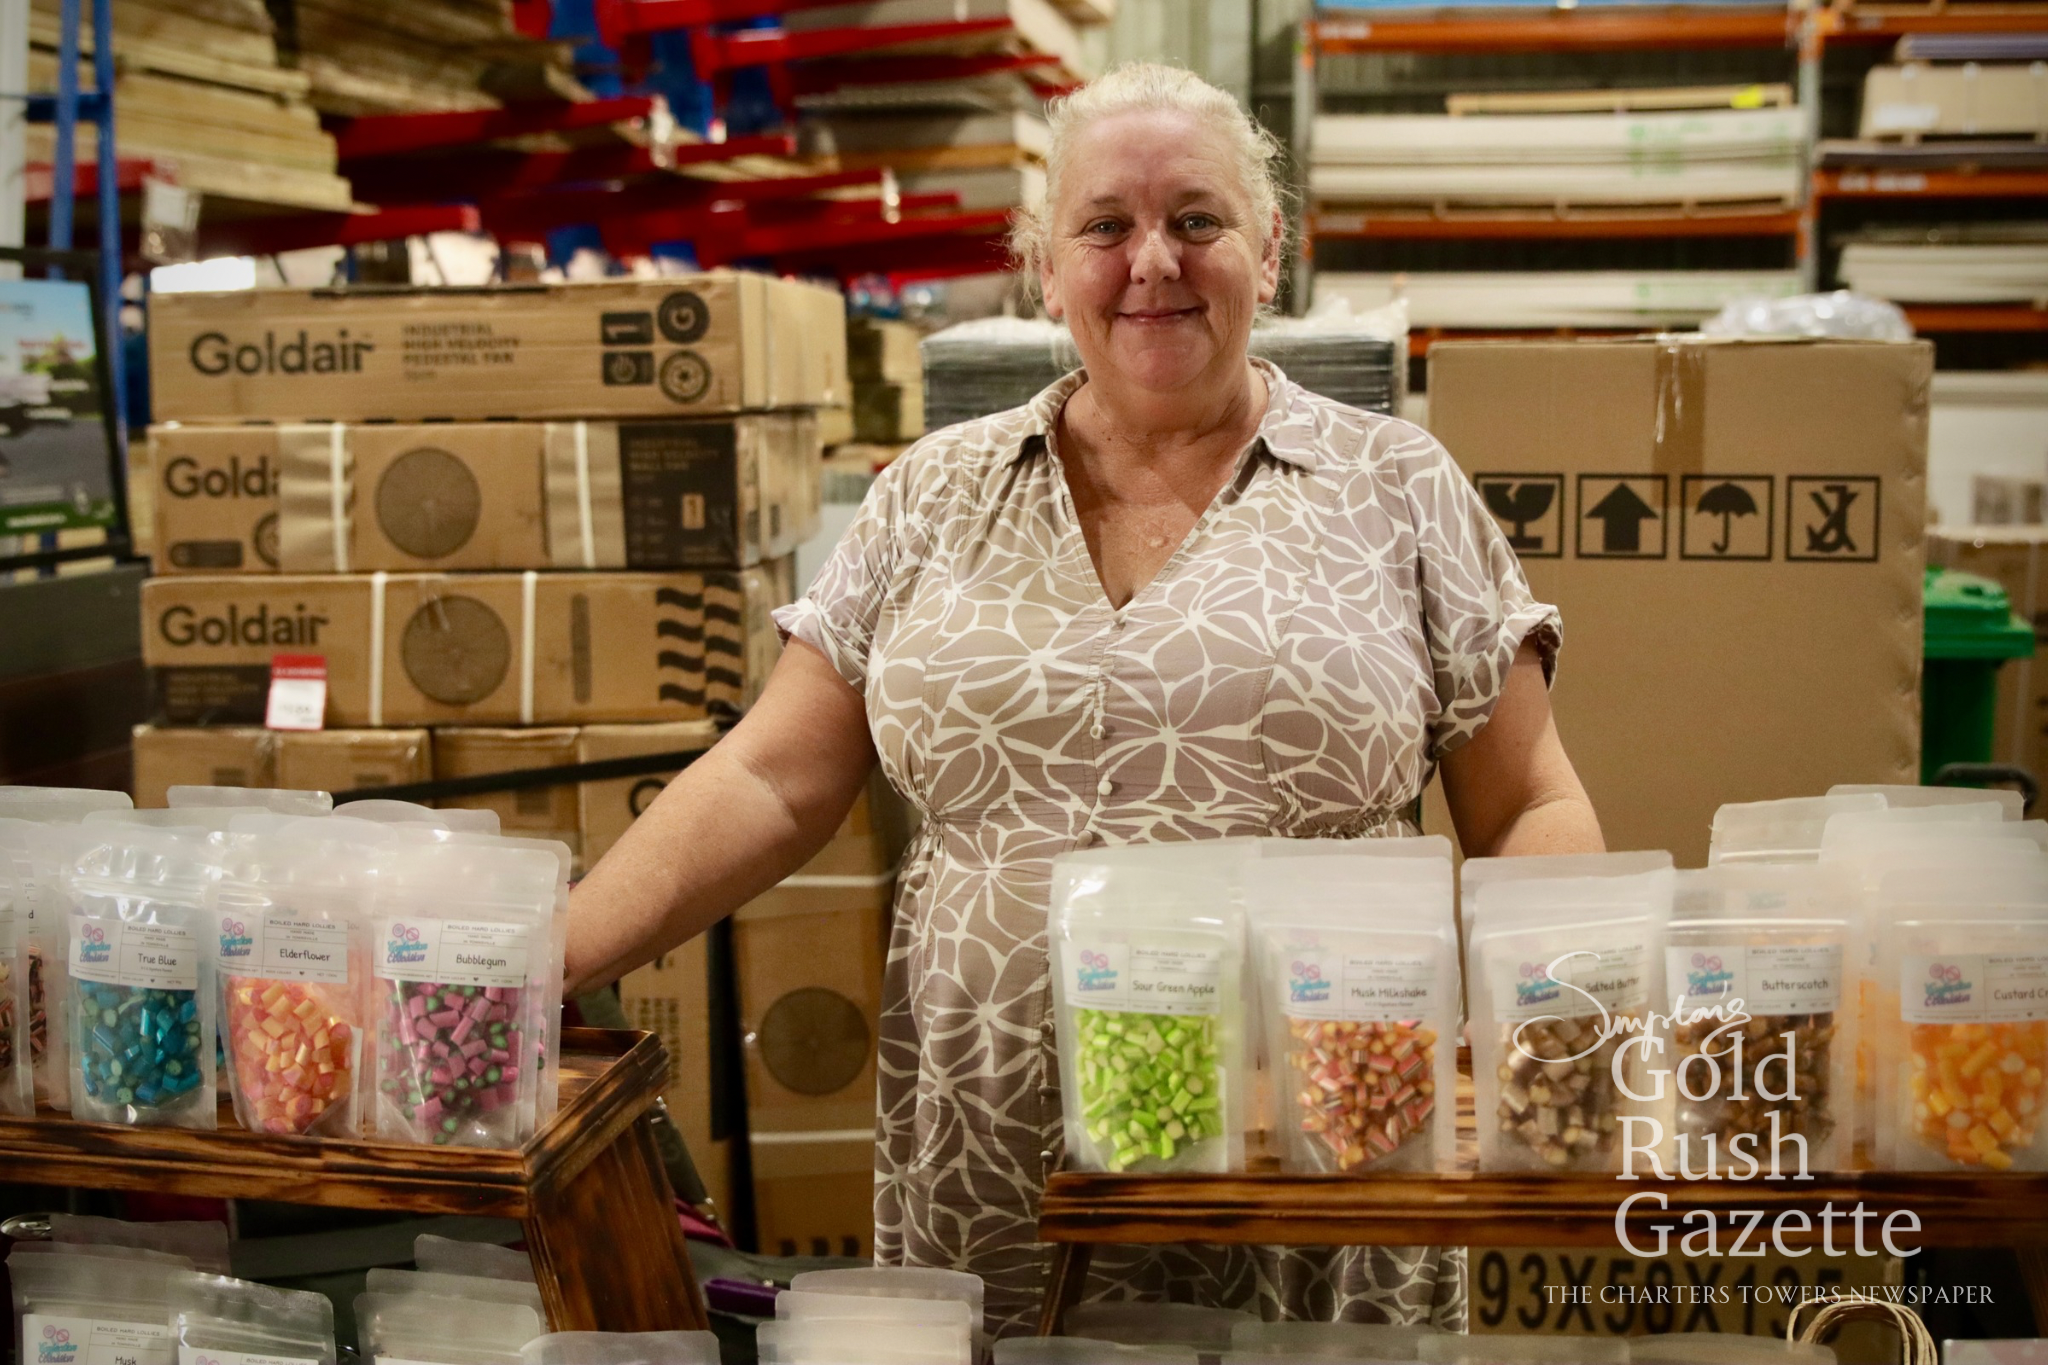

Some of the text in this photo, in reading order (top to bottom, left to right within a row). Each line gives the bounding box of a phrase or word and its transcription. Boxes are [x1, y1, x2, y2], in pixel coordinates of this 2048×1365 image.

[189, 329, 375, 376] Goldair
[160, 603, 329, 647] Goldair
[137, 952, 177, 966] True Blue
[279, 948, 331, 962] Elderflower
[456, 953, 507, 970] Bubblegum
[1133, 980, 1215, 997] Sour Green Apple
[1585, 981, 1615, 992] Salted
[1761, 978, 1829, 991] Butterscotch
[1351, 987, 1427, 998] Musk Milkshake
[1994, 987, 2035, 1000] Custard
[115, 1355, 137, 1365] Musk
